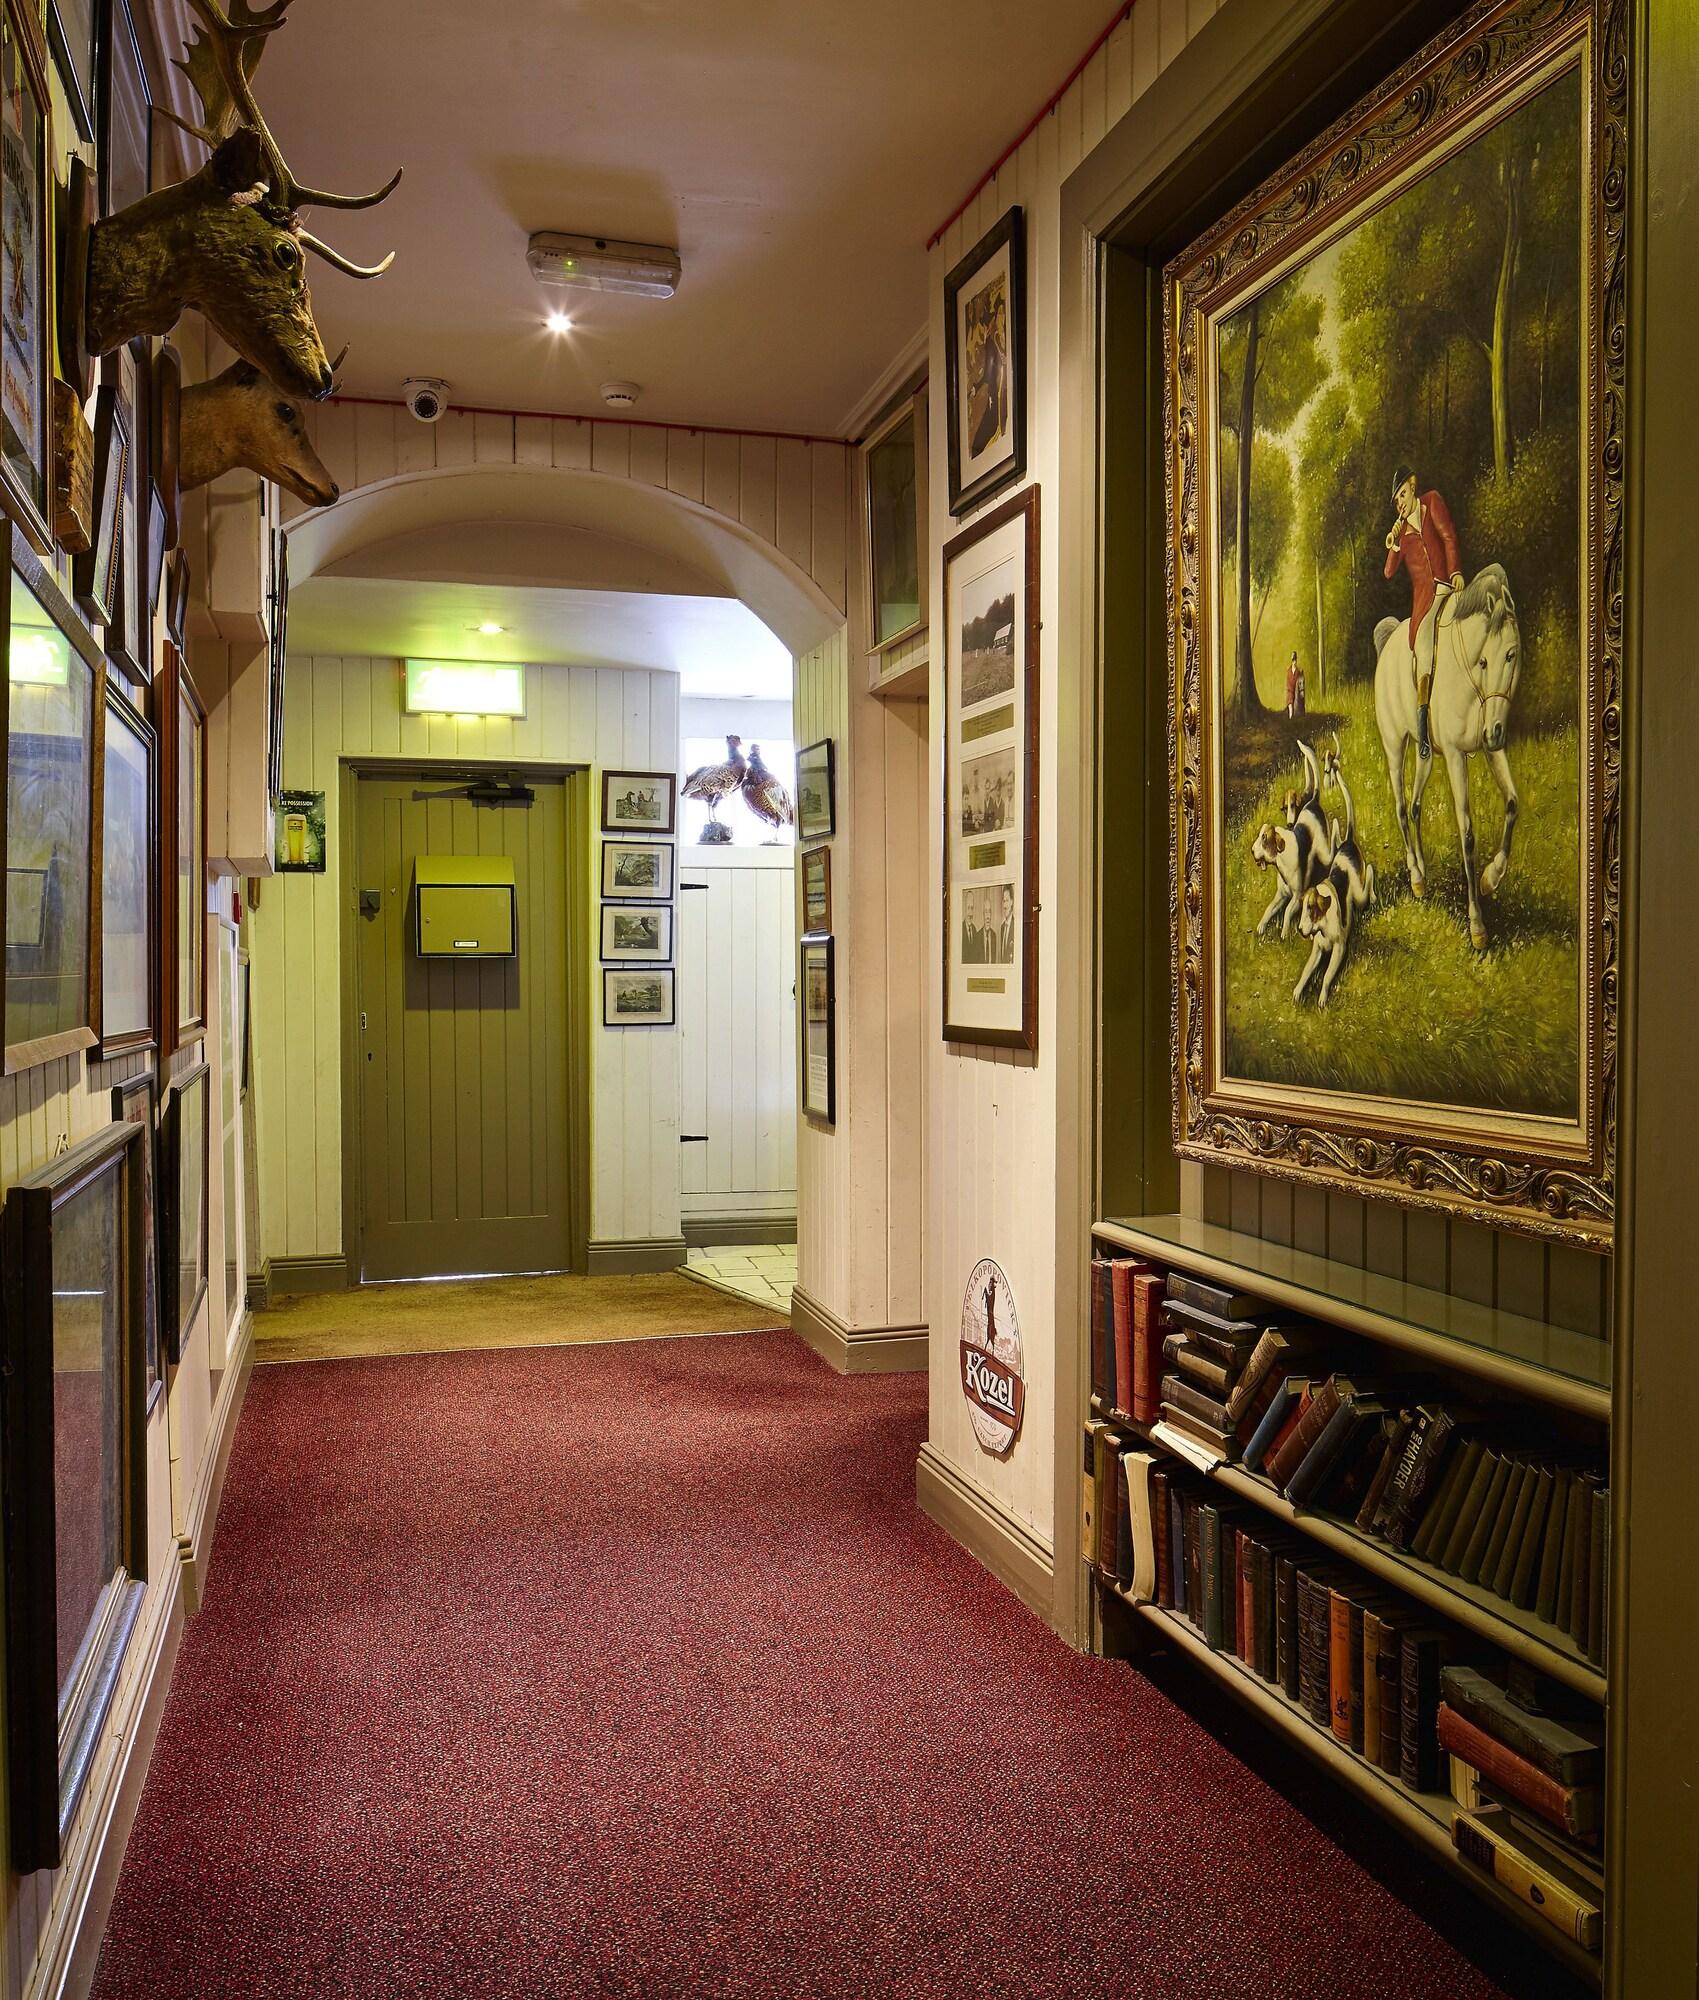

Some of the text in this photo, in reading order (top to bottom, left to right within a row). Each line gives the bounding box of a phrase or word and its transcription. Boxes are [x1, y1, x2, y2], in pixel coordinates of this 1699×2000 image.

[3, 134, 33, 241] JAMESON
[965, 1350, 1014, 1410] Kozel
[1393, 1439, 1420, 1490] HAYDER
